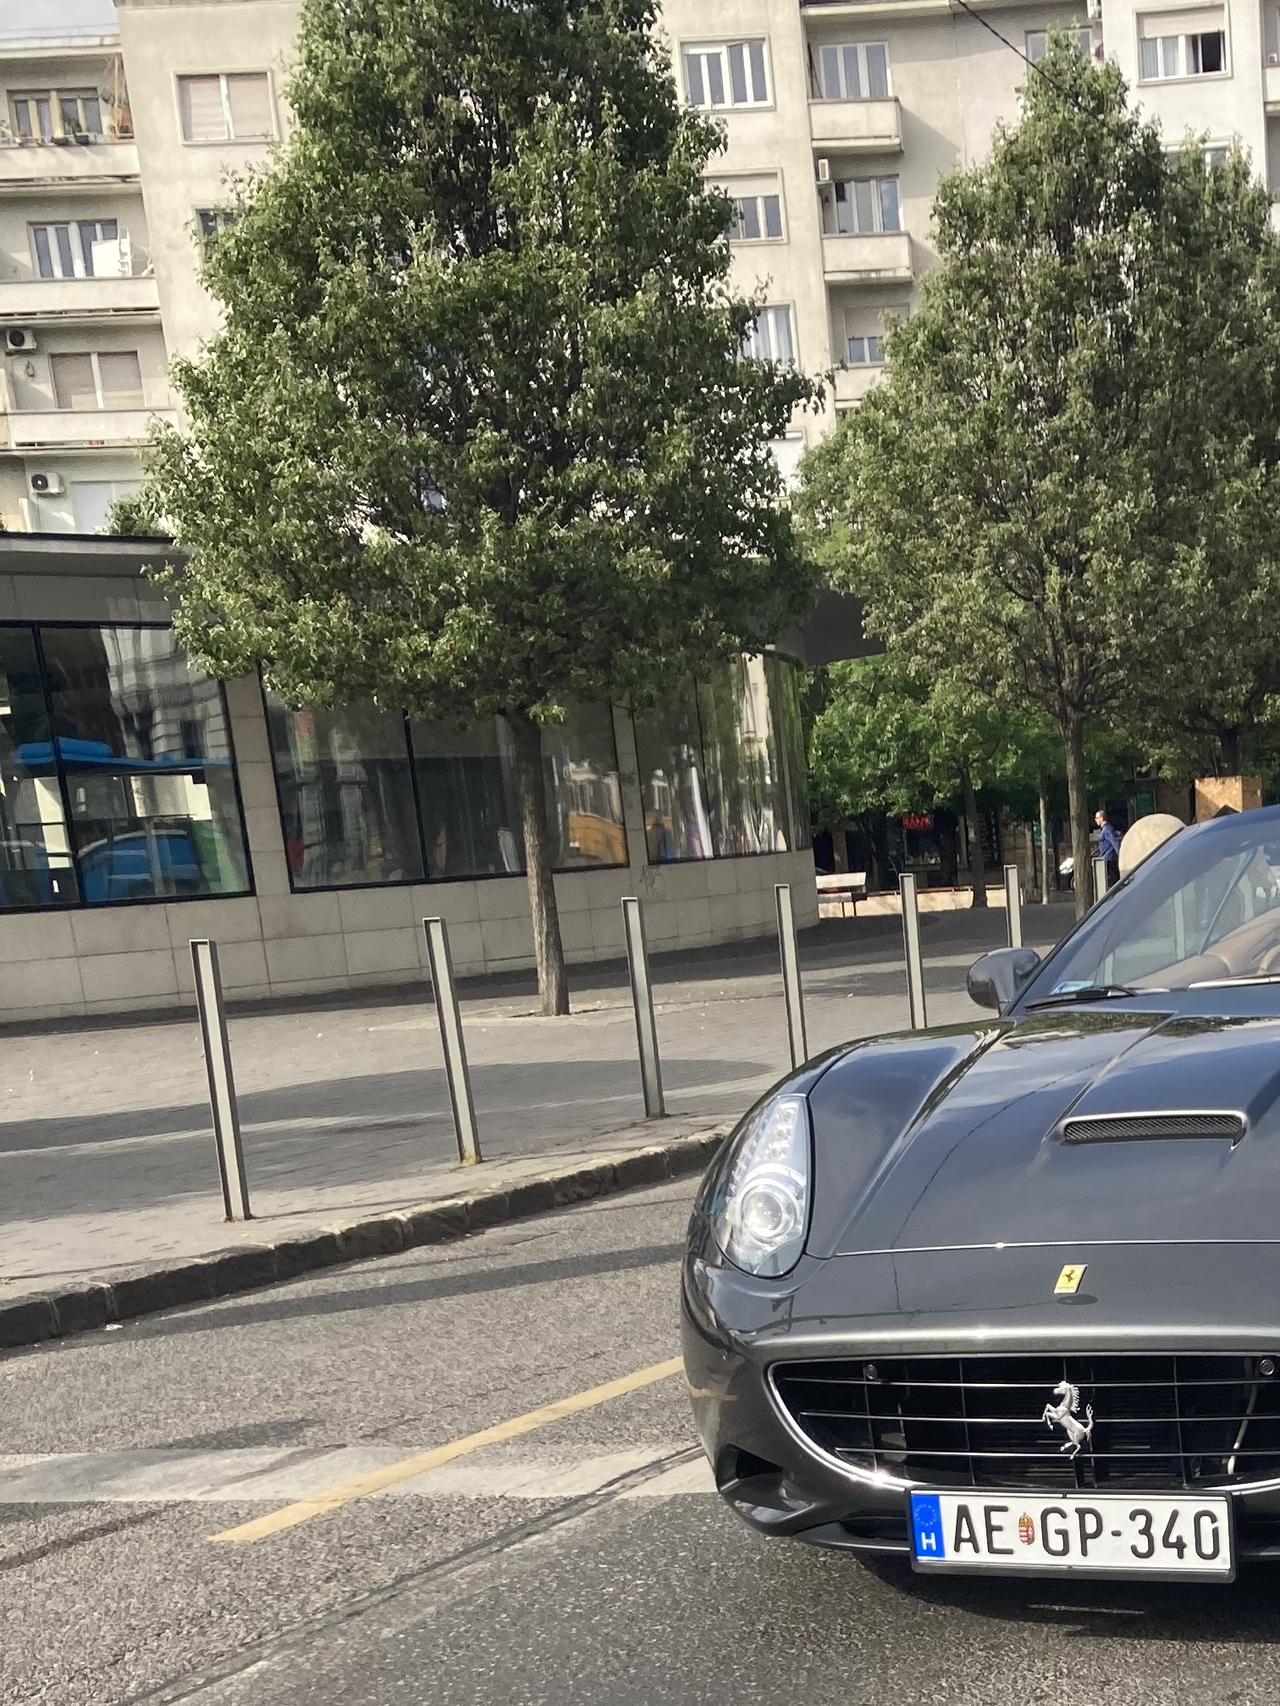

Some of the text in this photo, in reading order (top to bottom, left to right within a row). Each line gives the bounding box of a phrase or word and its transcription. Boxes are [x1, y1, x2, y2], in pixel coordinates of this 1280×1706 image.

[921, 1504, 1221, 1561] H AE GP-340
